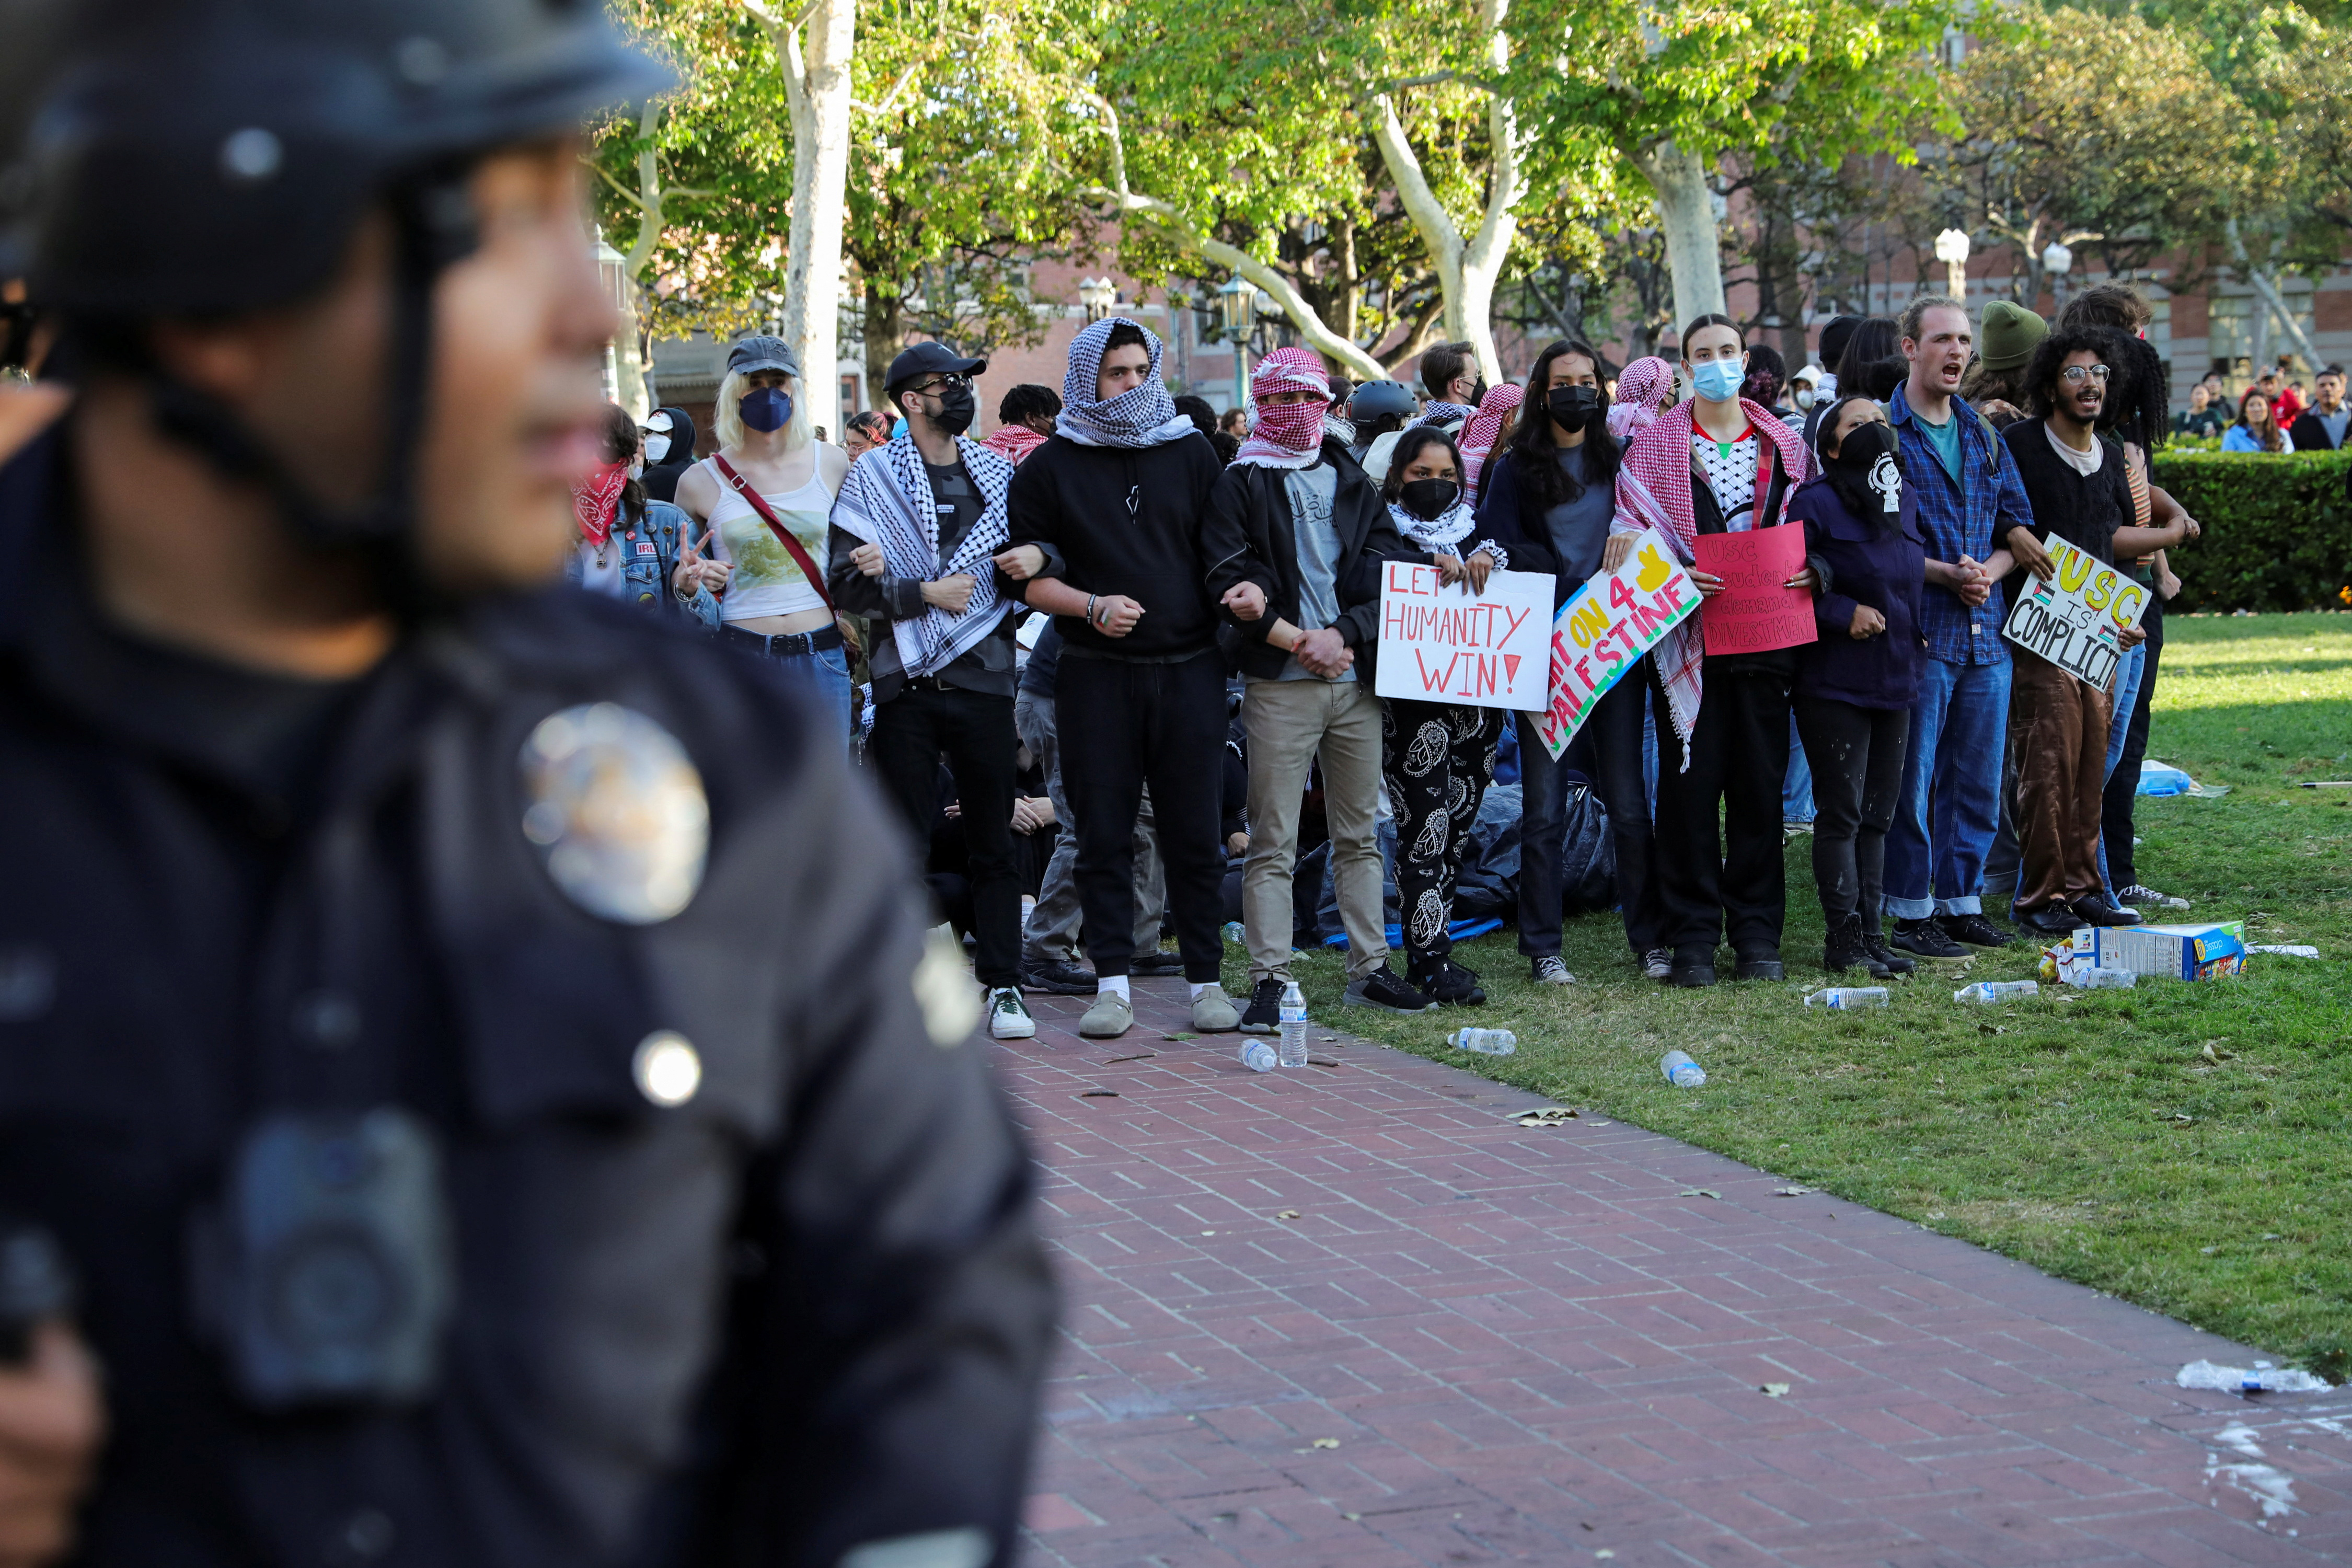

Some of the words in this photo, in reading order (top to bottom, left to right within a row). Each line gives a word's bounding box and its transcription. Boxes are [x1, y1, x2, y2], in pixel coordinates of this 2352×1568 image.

[638, 544, 656, 554] IRL
[1706, 540, 1758, 563] USC
[1390, 565, 1443, 597] LET
[1721, 587, 1794, 616] demand
[2059, 547, 2142, 629] USC
[1385, 600, 1531, 650] HUMANITY
[1570, 597, 1611, 649] ON
[1610, 575, 1638, 612] 4
[1708, 612, 1815, 648] DIVESTMENT
[2059, 600, 2092, 629] IS
[1541, 572, 1700, 752] PALESTINE
[2009, 598, 2121, 690] COMPLICIT
[1415, 648, 1521, 698] WIN!
